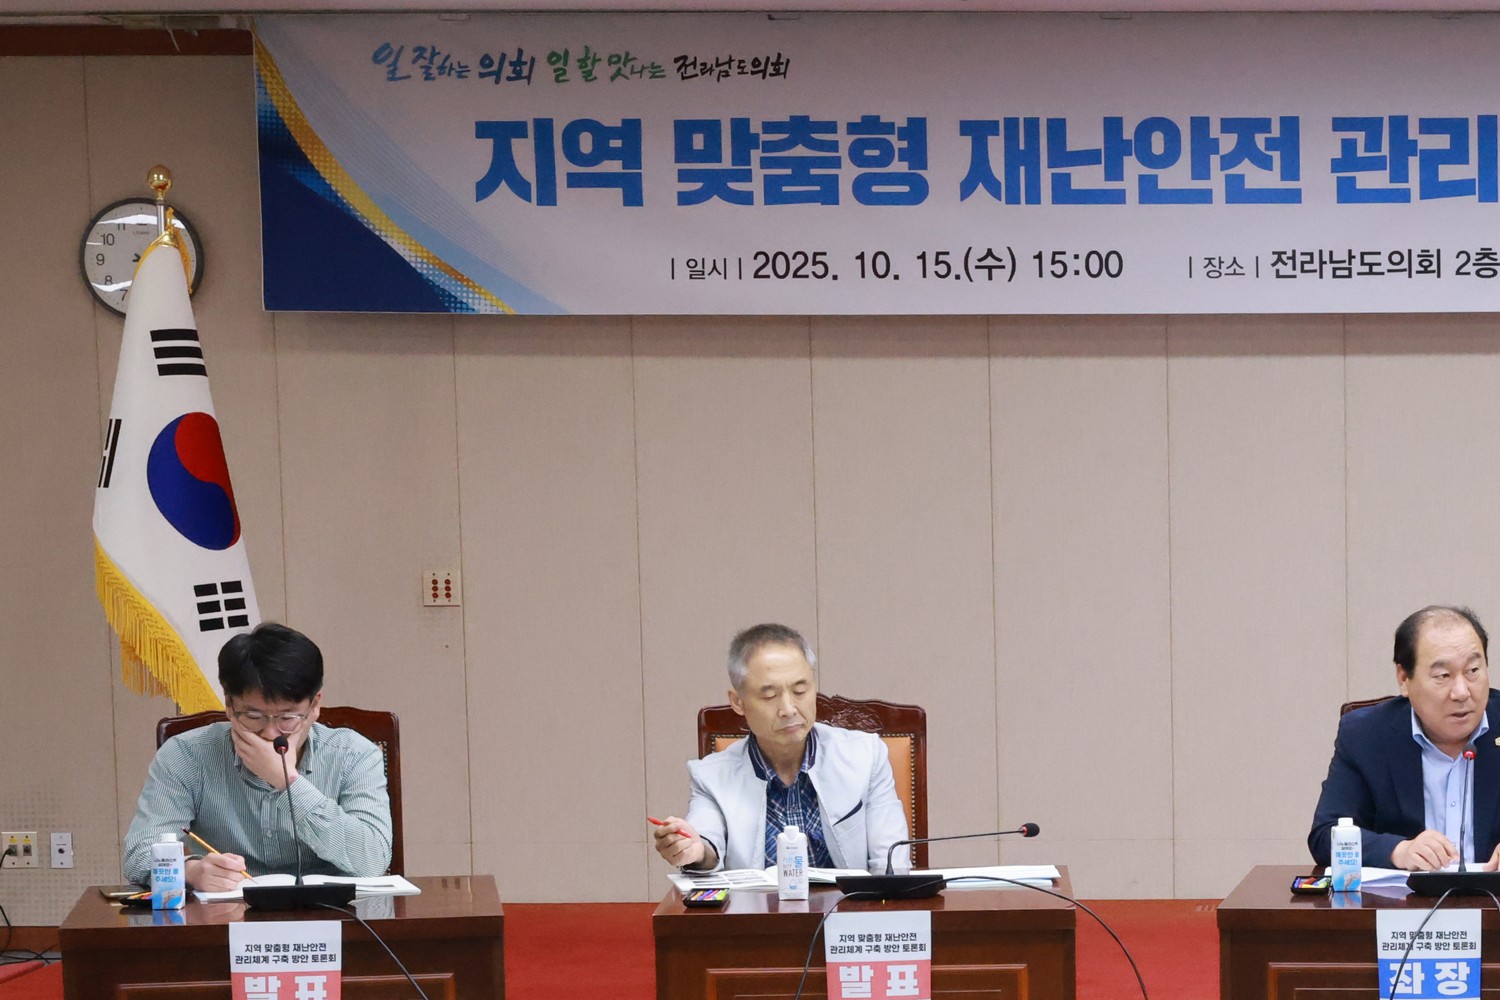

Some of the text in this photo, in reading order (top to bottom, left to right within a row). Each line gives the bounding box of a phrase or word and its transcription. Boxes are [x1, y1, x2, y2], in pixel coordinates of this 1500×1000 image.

[412, 46, 471, 80] 잘하는
[479, 48, 535, 85] 의회
[674, 53, 790, 82] 전라남도의회
[475, 118, 643, 206] 지역
[674, 115, 929, 205] 맞춤형
[959, 116, 1301, 204] 재난안전
[100, 233, 115, 246] 10
[95, 253, 105, 266] 9
[686, 258, 726, 279] 일시
[754, 251, 837, 280] 2025.
[856, 251, 899, 280] 10.
[1033, 251, 1123, 278] 15:00
[1204, 256, 1245, 278] 장소
[1271, 249, 1440, 279] 전라남도의회
[1456, 248, 1500, 278] 2층
[121, 289, 129, 302] 7
[783, 868, 803, 877] WATER
[839, 932, 918, 943] 지역 맞춤형 재난안전
[1391, 931, 1407, 940] 지역
[1435, 930, 1468, 940] 재난안전
[244, 942, 328, 955] 지역 맞춤형 재난안전
[830, 943, 927, 955] 관리체계 구축 방안 토론회
[1416, 942, 1432, 951] 구축
[1434, 941, 1451, 951] 방안
[1452, 941, 1477, 951] 토론회
[234, 953, 338, 965] 관리체계 구축 방안 토론회
